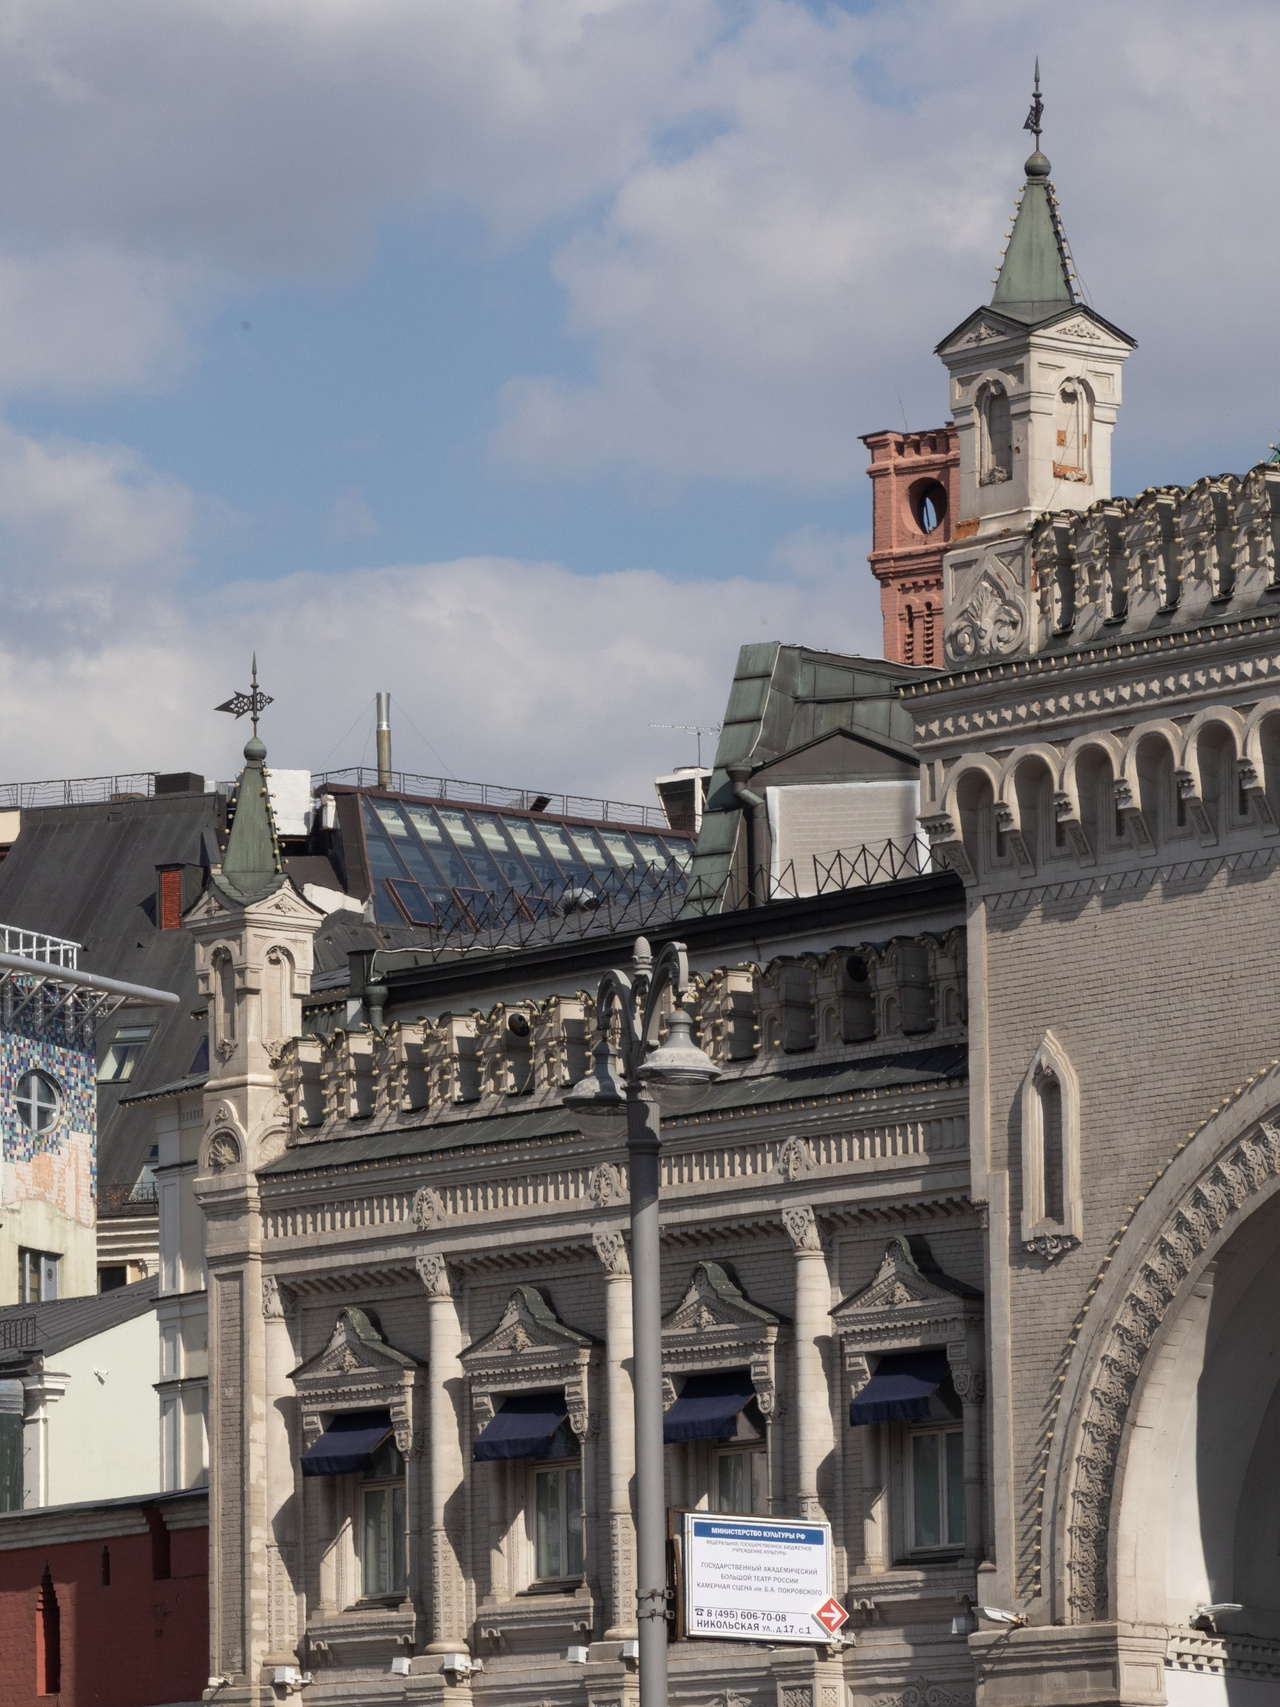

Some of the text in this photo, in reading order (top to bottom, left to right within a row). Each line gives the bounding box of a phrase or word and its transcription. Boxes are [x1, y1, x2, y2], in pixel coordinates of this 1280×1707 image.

[711, 1527, 762, 1537] МИНИСТЕРСТВО
[763, 1530, 795, 1539] КУЛЬТУРЫ
[701, 1562, 818, 1575] ГОСУДАРСТВЕННЫЙ АКАДЕМИЧЕСКИЙ
[720, 1573, 752, 1581] БОЛЬШОЙ
[773, 1576, 799, 1584] РОССИИ
[696, 1582, 731, 1590] КАМЕРНАЯ
[778, 1587, 823, 1596] ПОКРОВСКОГО
[706, 1609, 787, 1622] 8 (495) 606-70-08
[697, 1619, 760, 1631] НИКОЛЬСКАЯ
